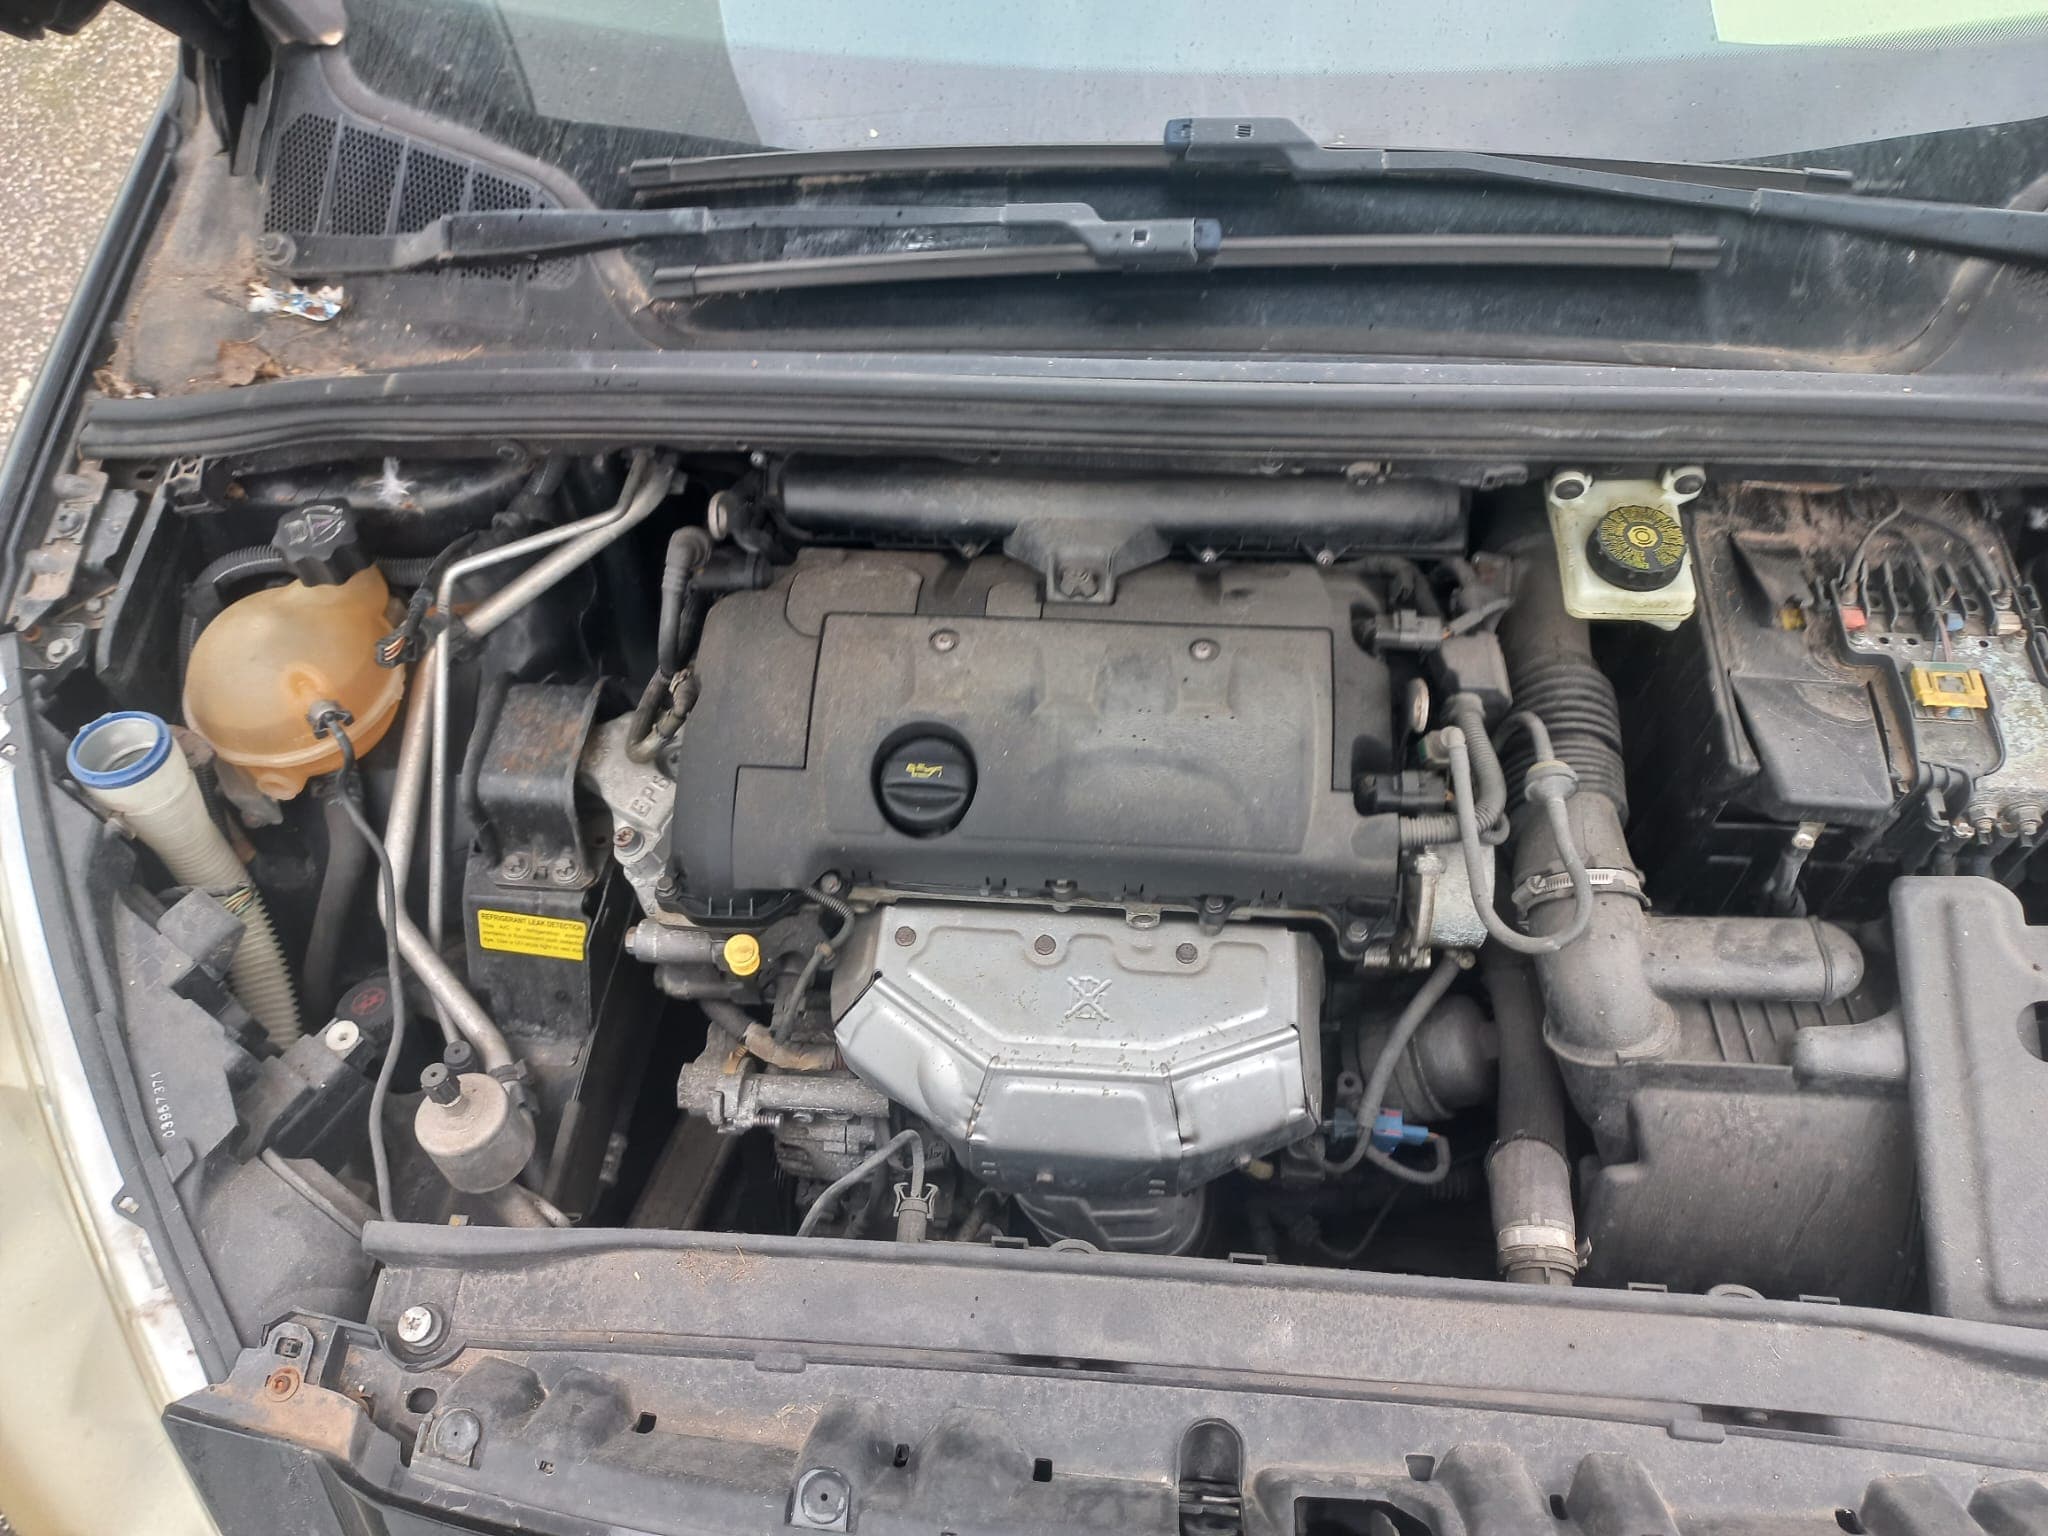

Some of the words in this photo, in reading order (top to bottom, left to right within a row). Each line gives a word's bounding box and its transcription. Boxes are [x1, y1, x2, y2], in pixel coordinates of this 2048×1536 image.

[481, 912, 527, 924] REFRIGERANT
[528, 918, 545, 926] LEAK
[547, 920, 584, 931] DETECTION
